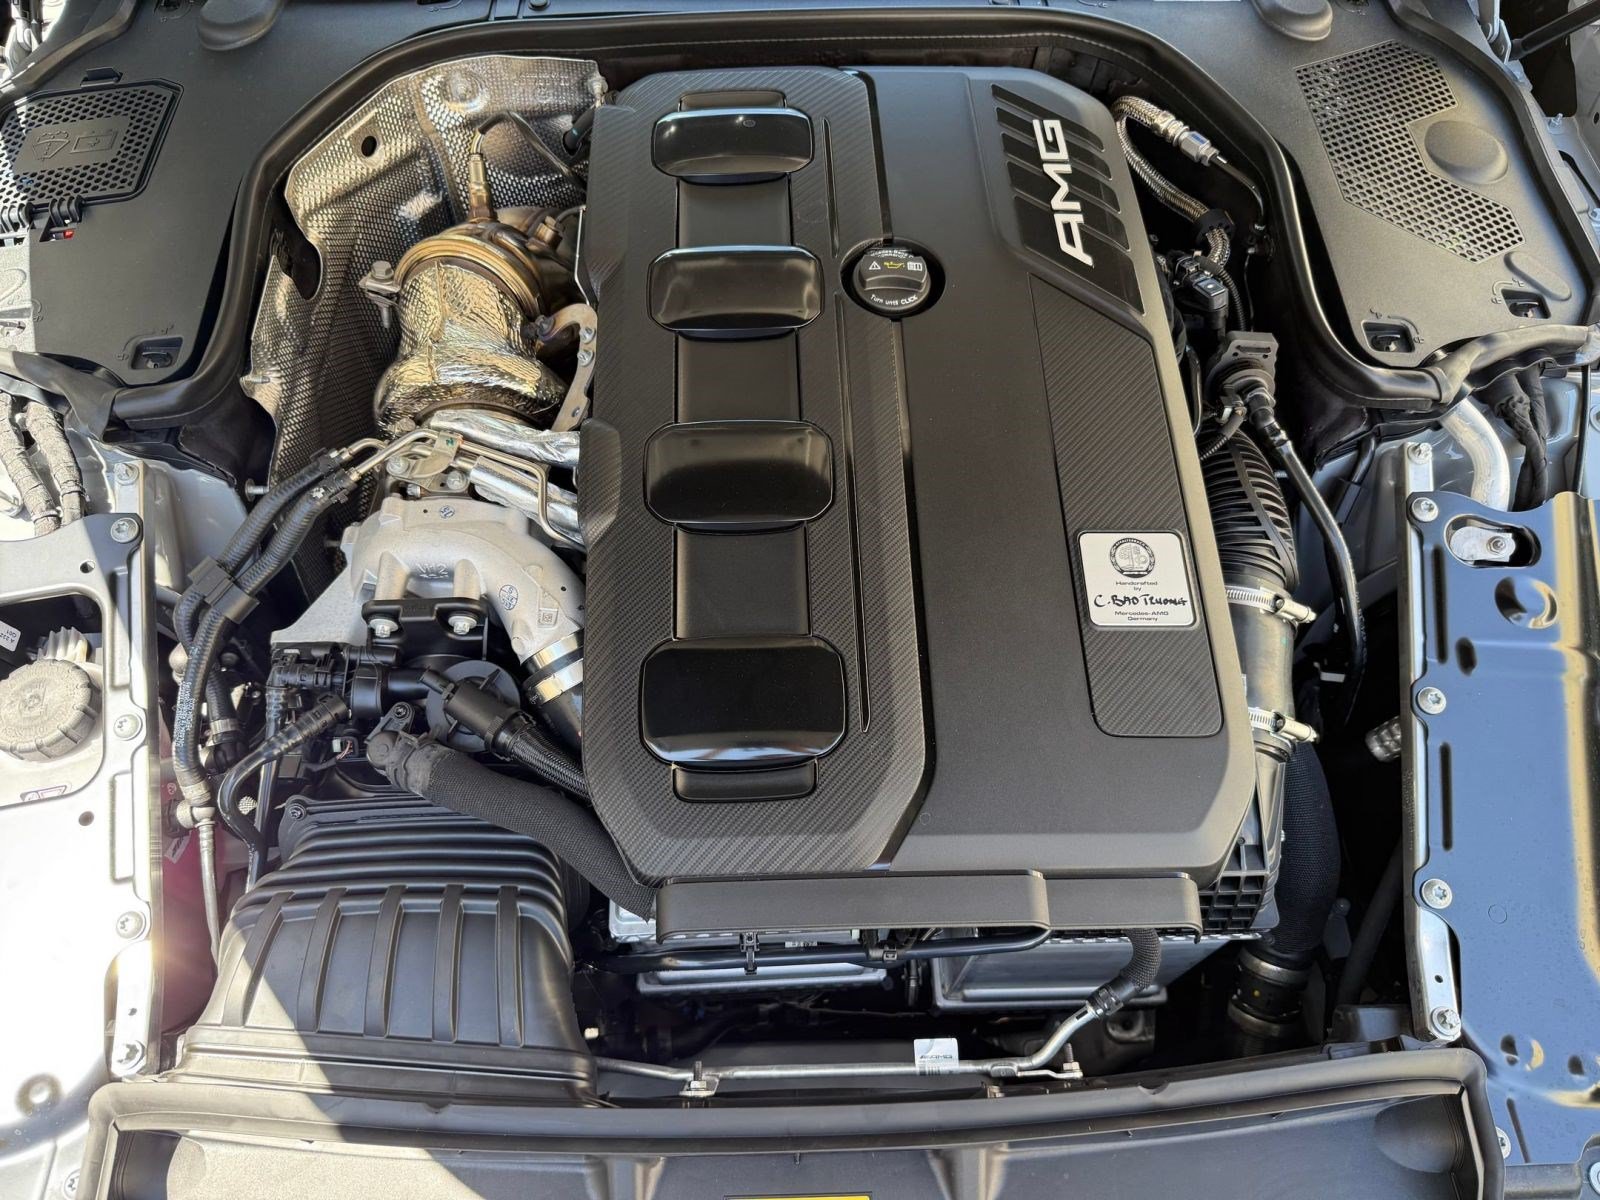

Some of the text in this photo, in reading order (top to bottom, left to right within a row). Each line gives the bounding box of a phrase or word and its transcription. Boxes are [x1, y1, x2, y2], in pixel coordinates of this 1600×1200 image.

[1032, 119, 1094, 268] AMG
[870, 294, 884, 303] Turn
[900, 294, 918, 305] CLICK
